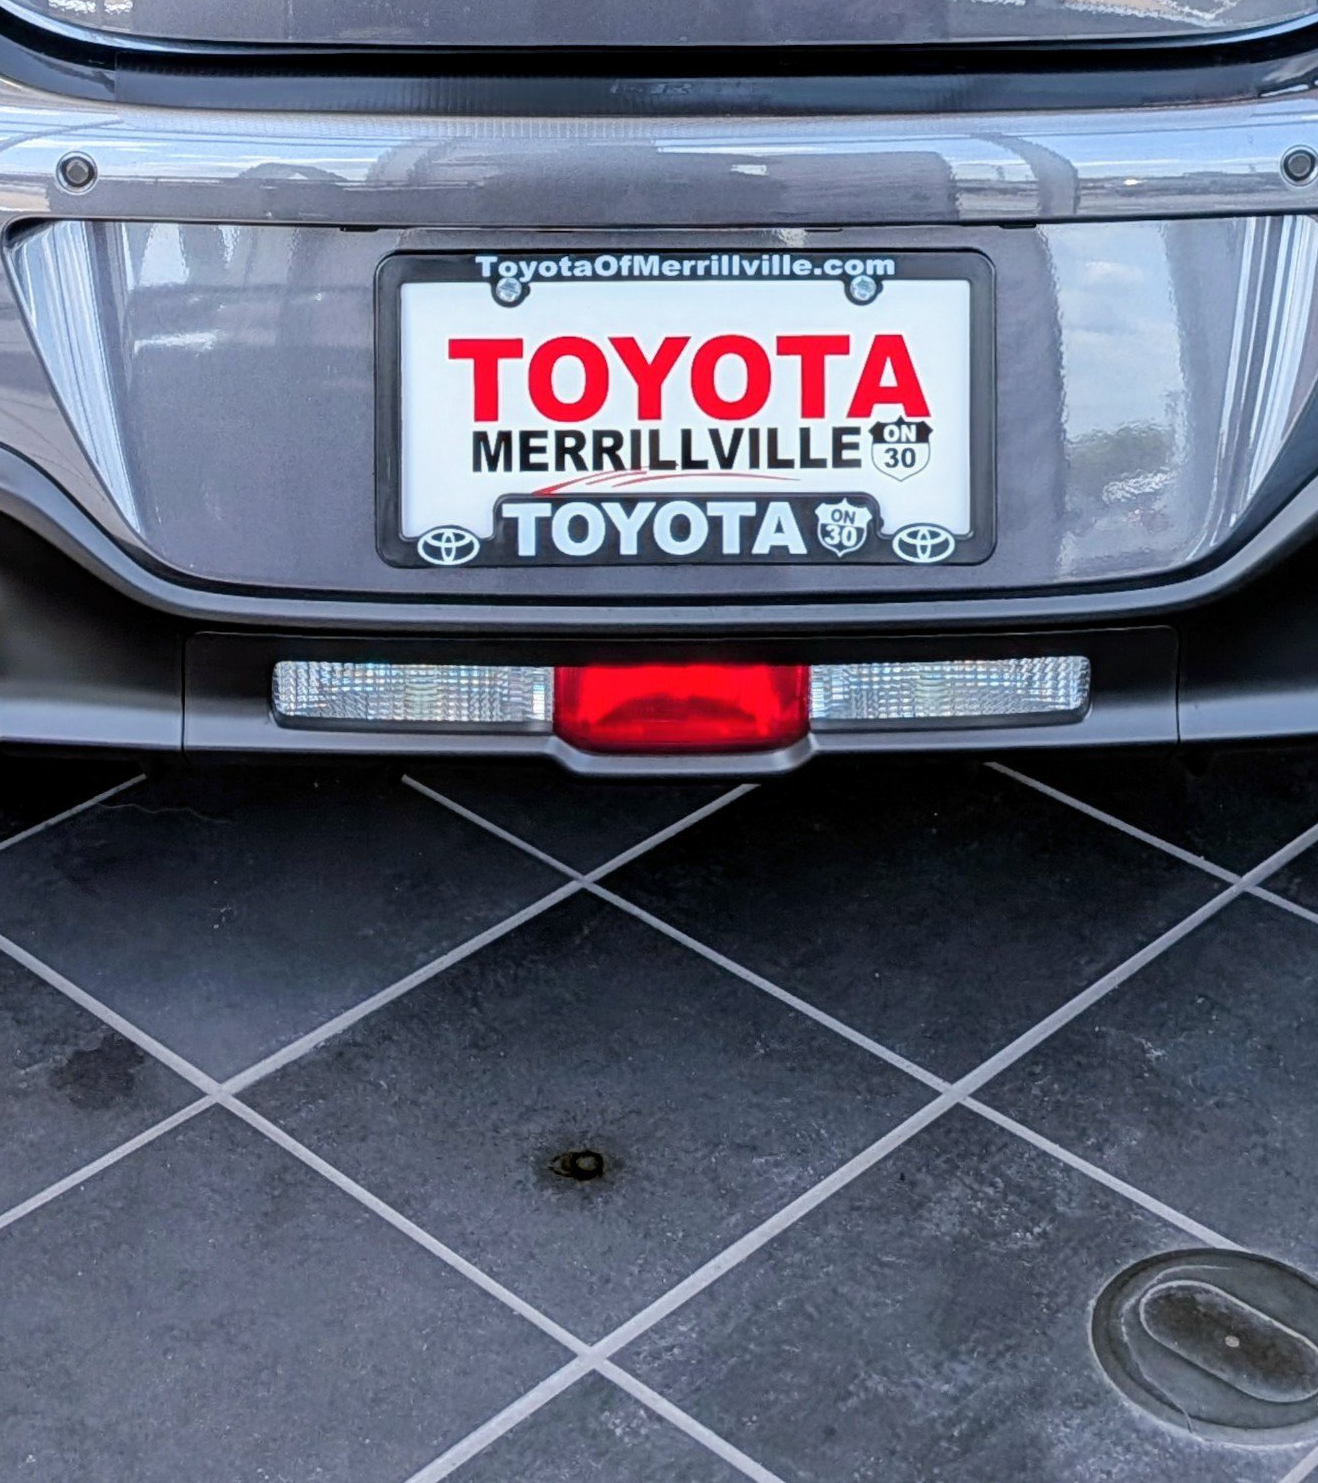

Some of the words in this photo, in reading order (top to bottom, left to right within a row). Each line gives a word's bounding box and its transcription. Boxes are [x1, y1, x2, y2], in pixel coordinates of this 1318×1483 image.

[475, 254, 895, 282] ToyotaOfMerrillville.com
[447, 334, 932, 422] TOYOTA
[883, 425, 917, 443] ON
[472, 426, 862, 473] MERRILLVILLE
[884, 447, 917, 469] 30
[502, 501, 808, 558] TOYOTA
[832, 509, 856, 525] ON
[825, 524, 858, 547] 30
